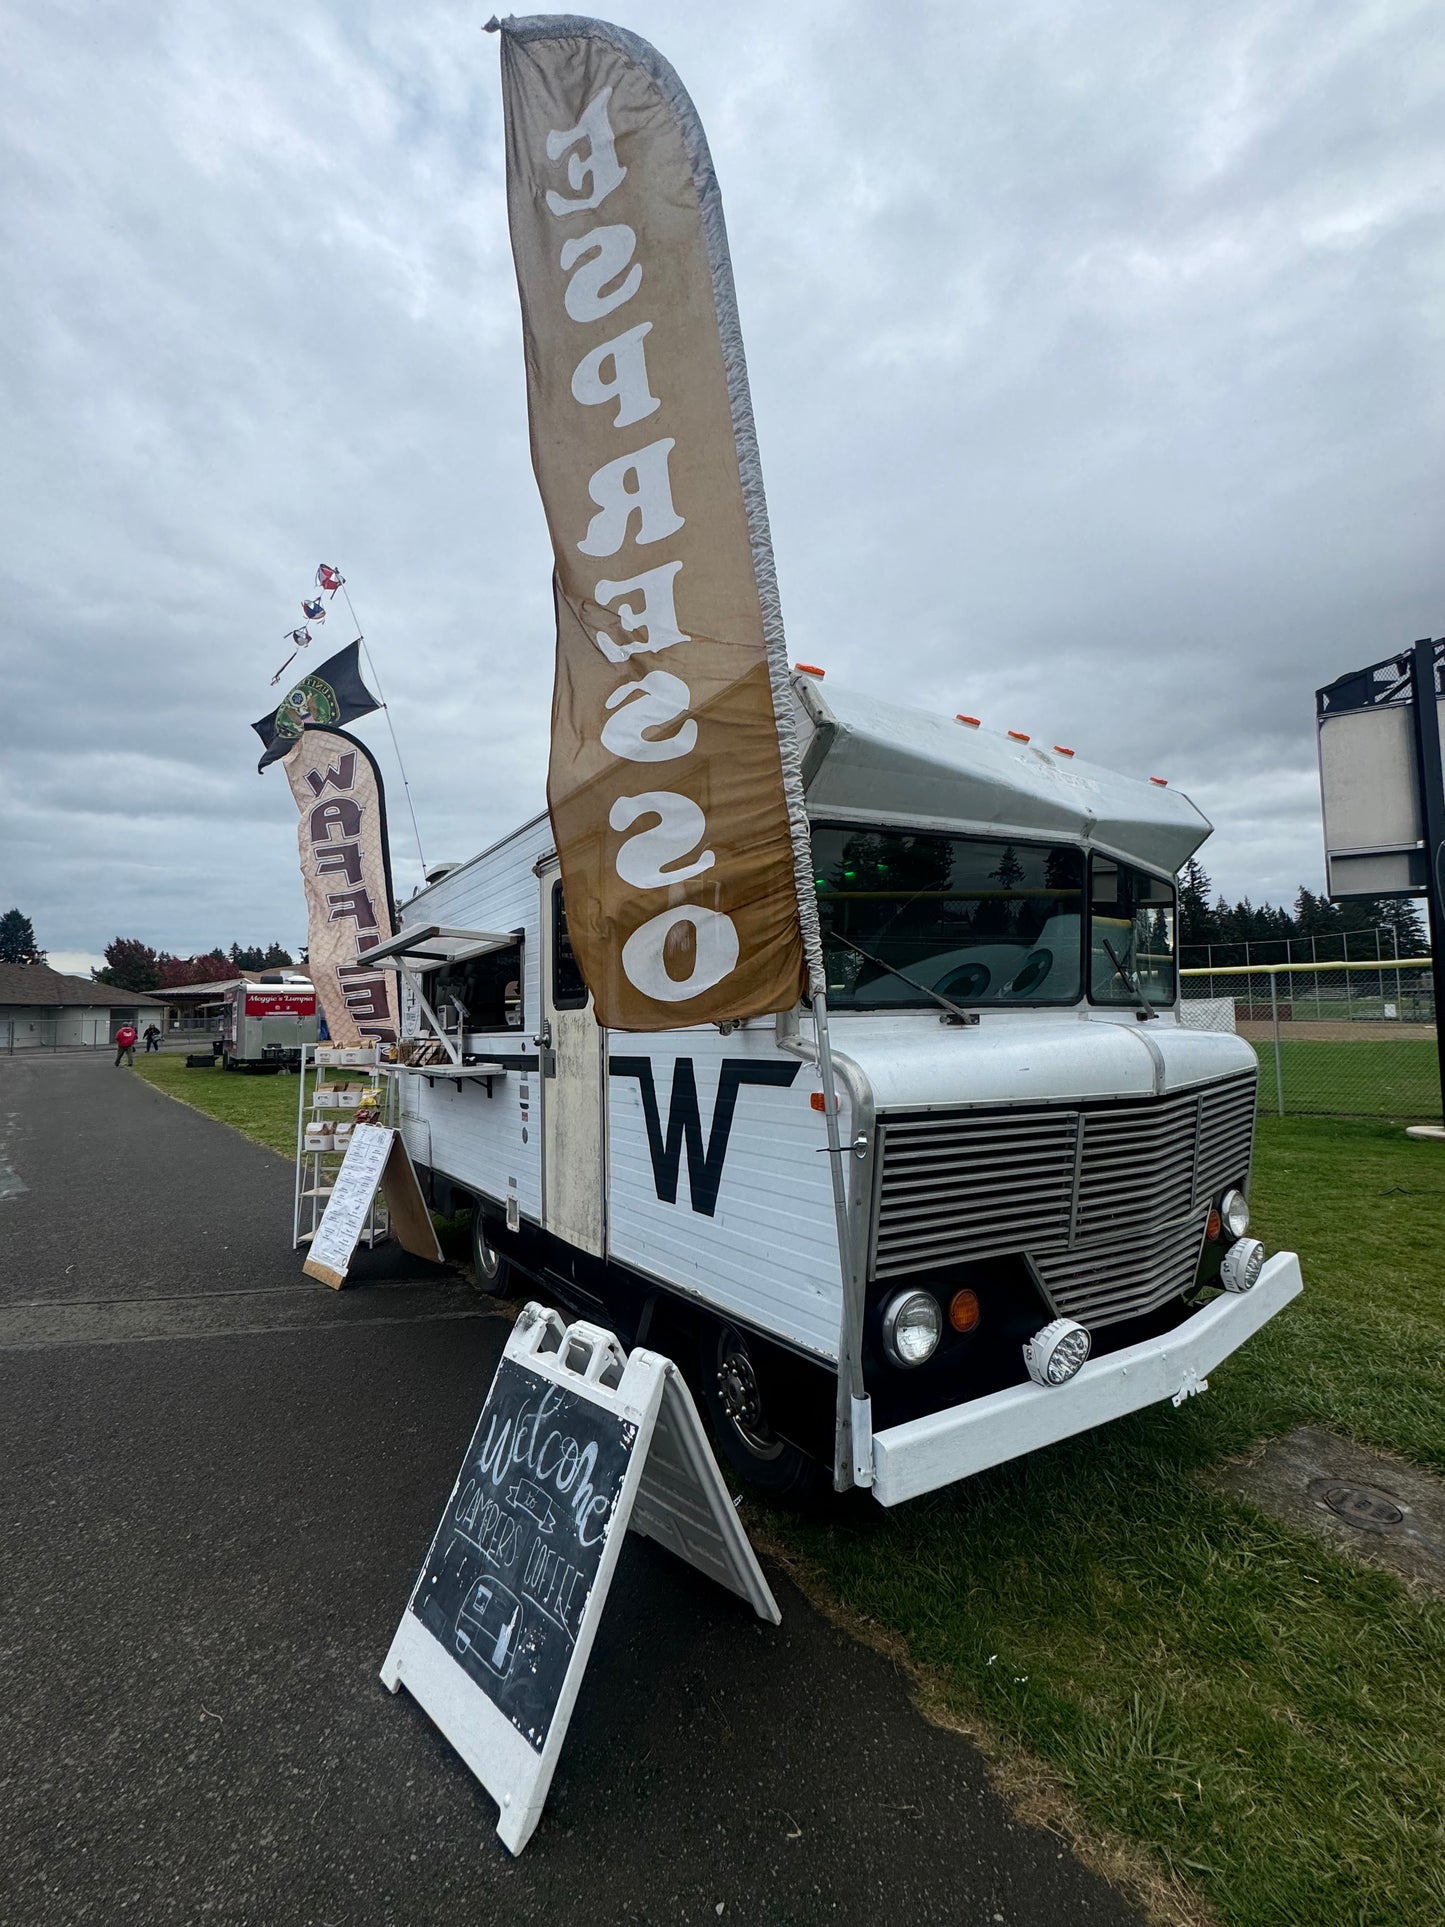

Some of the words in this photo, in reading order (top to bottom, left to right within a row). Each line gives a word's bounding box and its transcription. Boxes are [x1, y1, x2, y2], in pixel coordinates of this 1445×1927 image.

[479, 1384, 610, 1547] Welcome
[525, 1489, 538, 1510] to
[454, 1478, 523, 1567] CAMPERS
[523, 1536, 585, 1624] COFFEE
